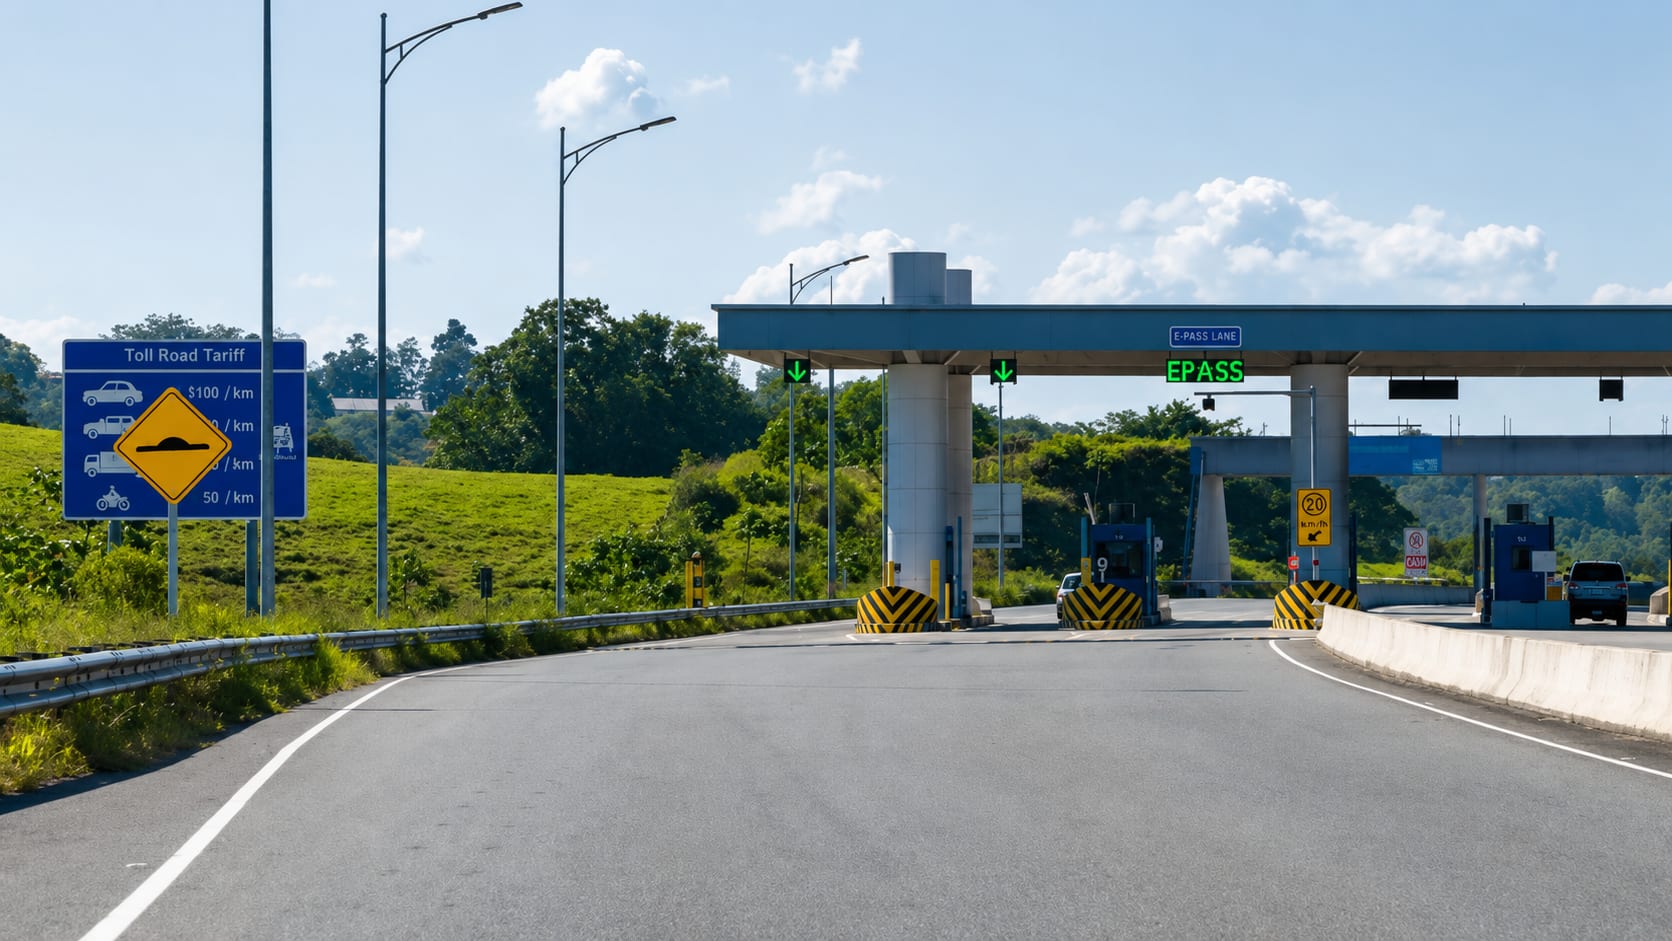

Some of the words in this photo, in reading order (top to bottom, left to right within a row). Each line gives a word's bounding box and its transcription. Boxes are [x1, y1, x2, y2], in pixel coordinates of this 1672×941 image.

[1174, 331, 1208, 341] E-PASS
[1211, 331, 1237, 341] LANE
[124, 348, 153, 362] Toll
[158, 348, 198, 362] Road
[203, 348, 246, 362] Tariff
[1167, 360, 1244, 382] EPASS
[188, 385, 219, 400] $100
[203, 491, 219, 504] 50
[1306, 497, 1323, 511] 20
